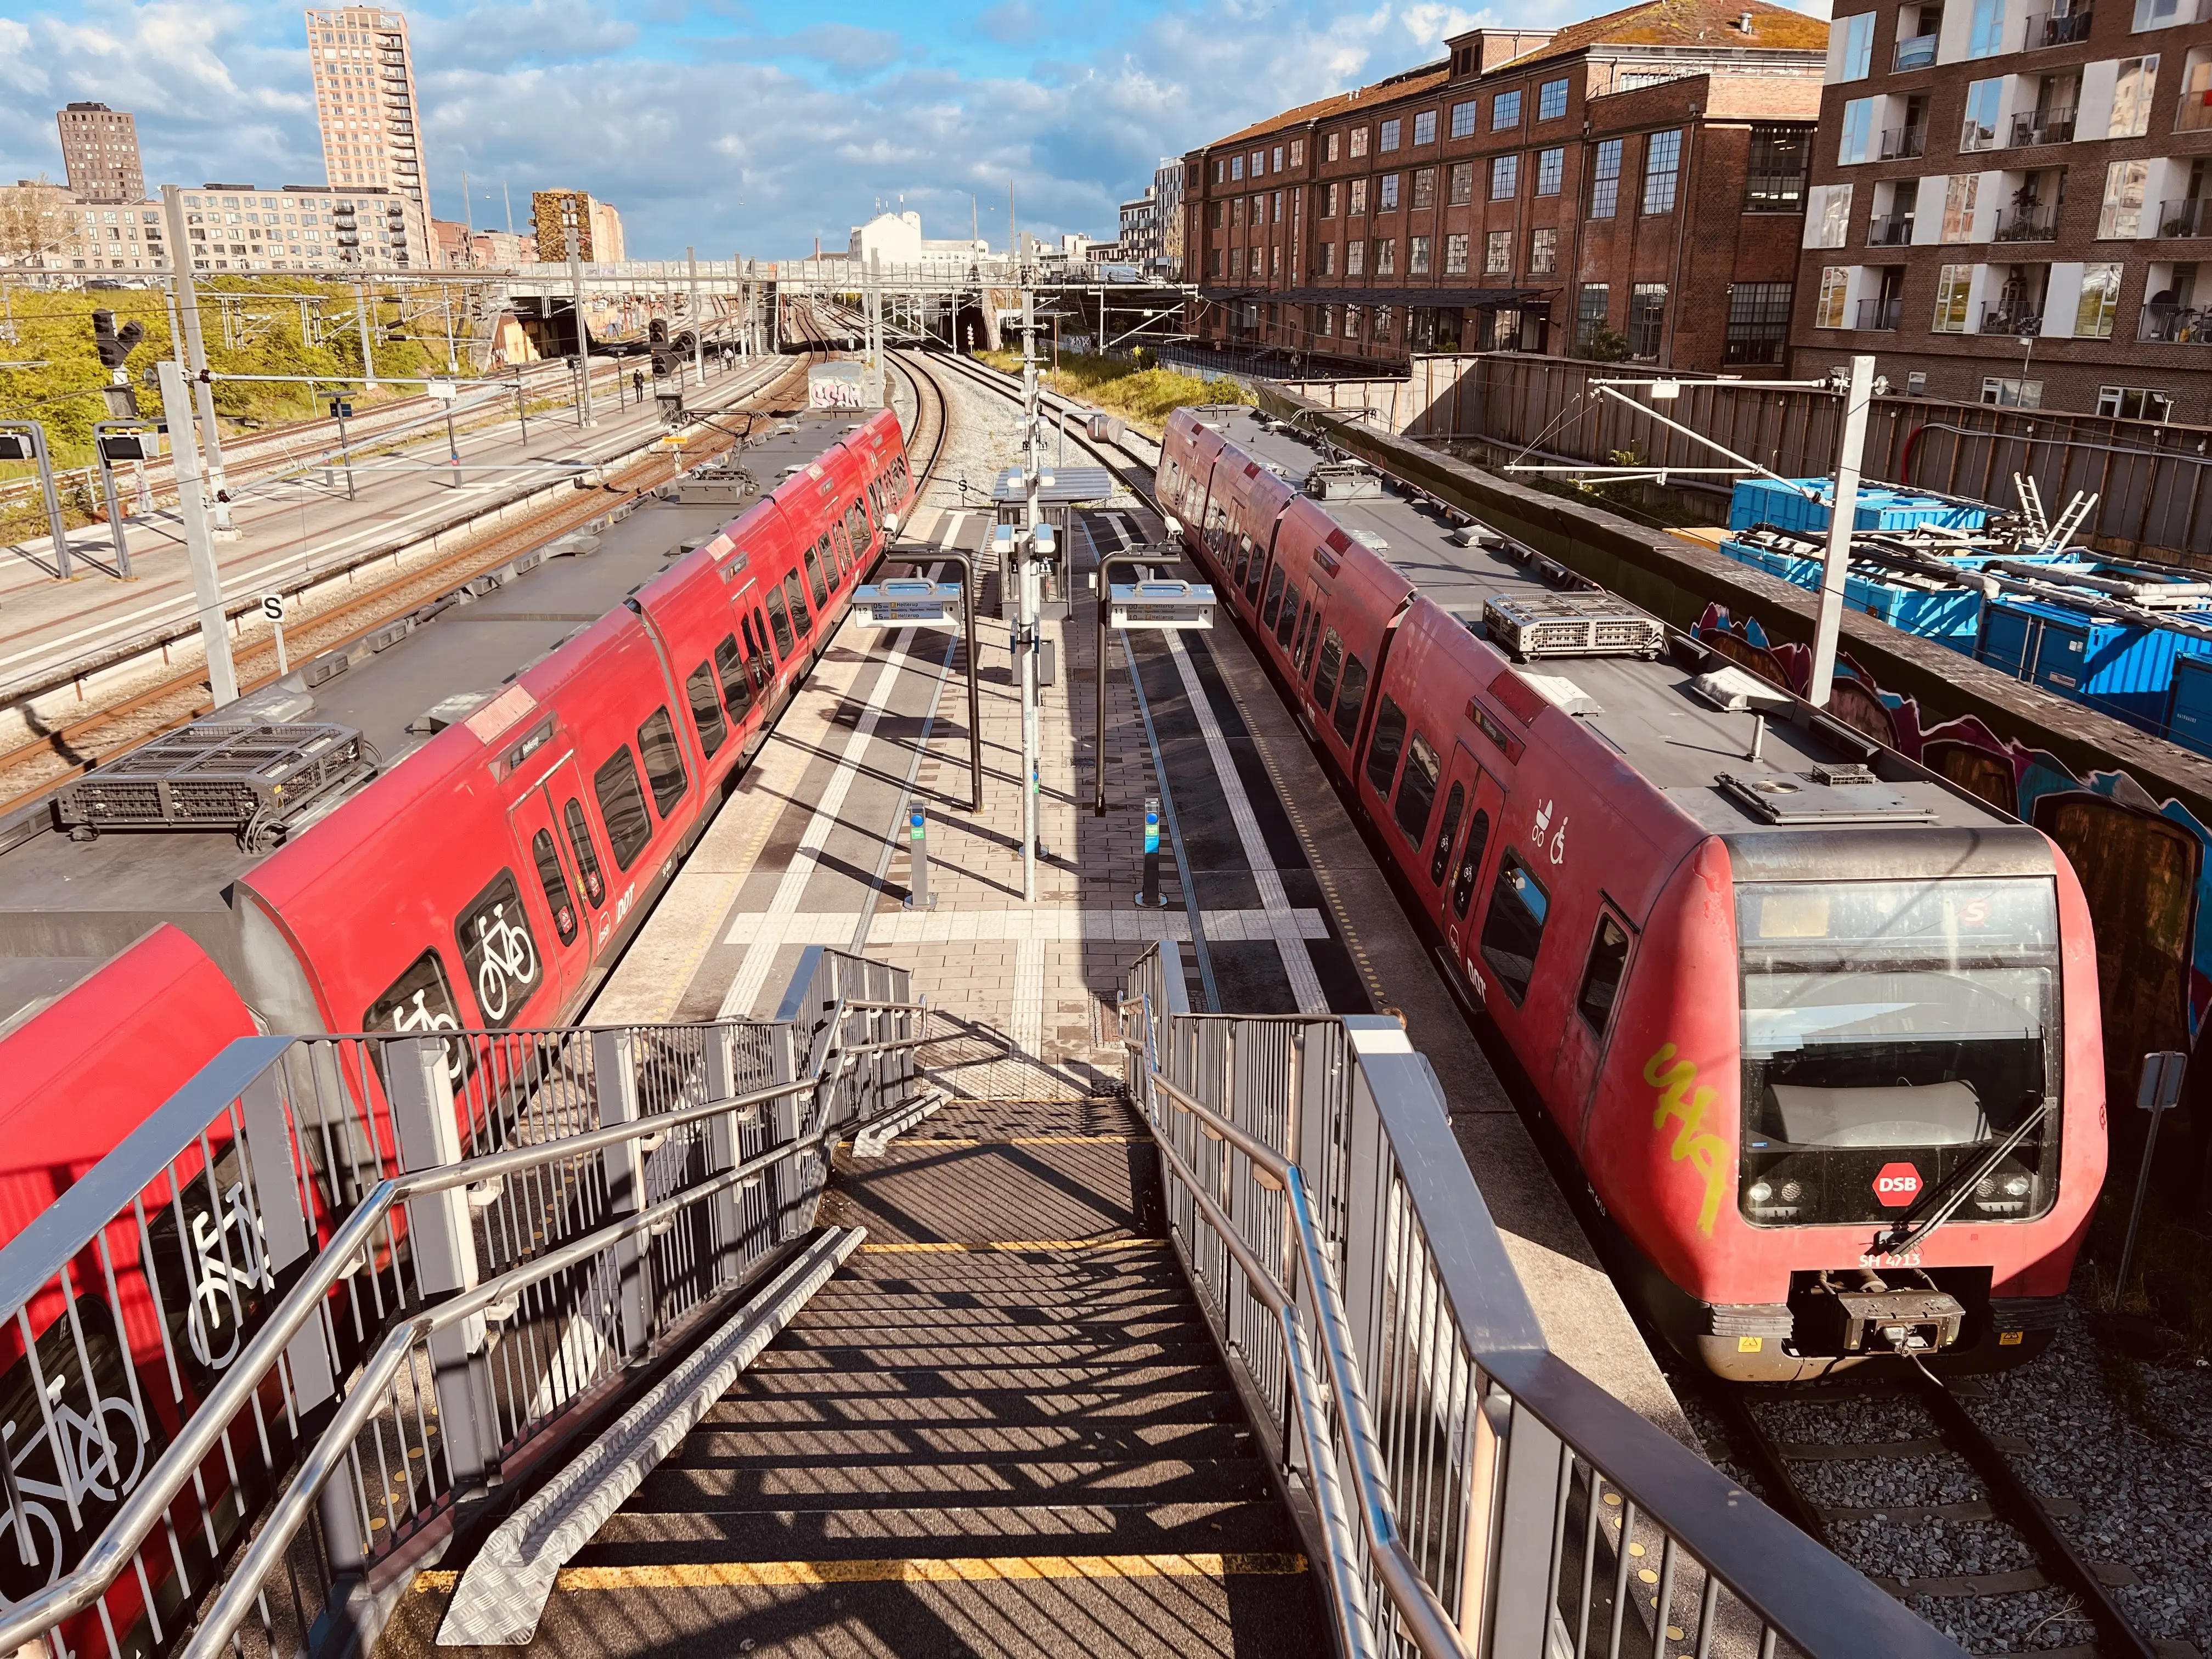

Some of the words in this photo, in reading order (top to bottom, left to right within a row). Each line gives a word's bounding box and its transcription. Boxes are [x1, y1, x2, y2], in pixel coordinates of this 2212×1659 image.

[958, 480, 967, 492] S
[1040, 564, 1051, 572] 11
[264, 597, 282, 619] S
[522, 736, 539, 755] Hellerup
[617, 882, 635, 924] DOT
[1965, 902, 1985, 922] S
[1467, 957, 1486, 1004] DOT
[1880, 1177, 1917, 1192] DSB
[1858, 1254, 1880, 1268] SH
[1885, 1253, 1921, 1267] 4713
